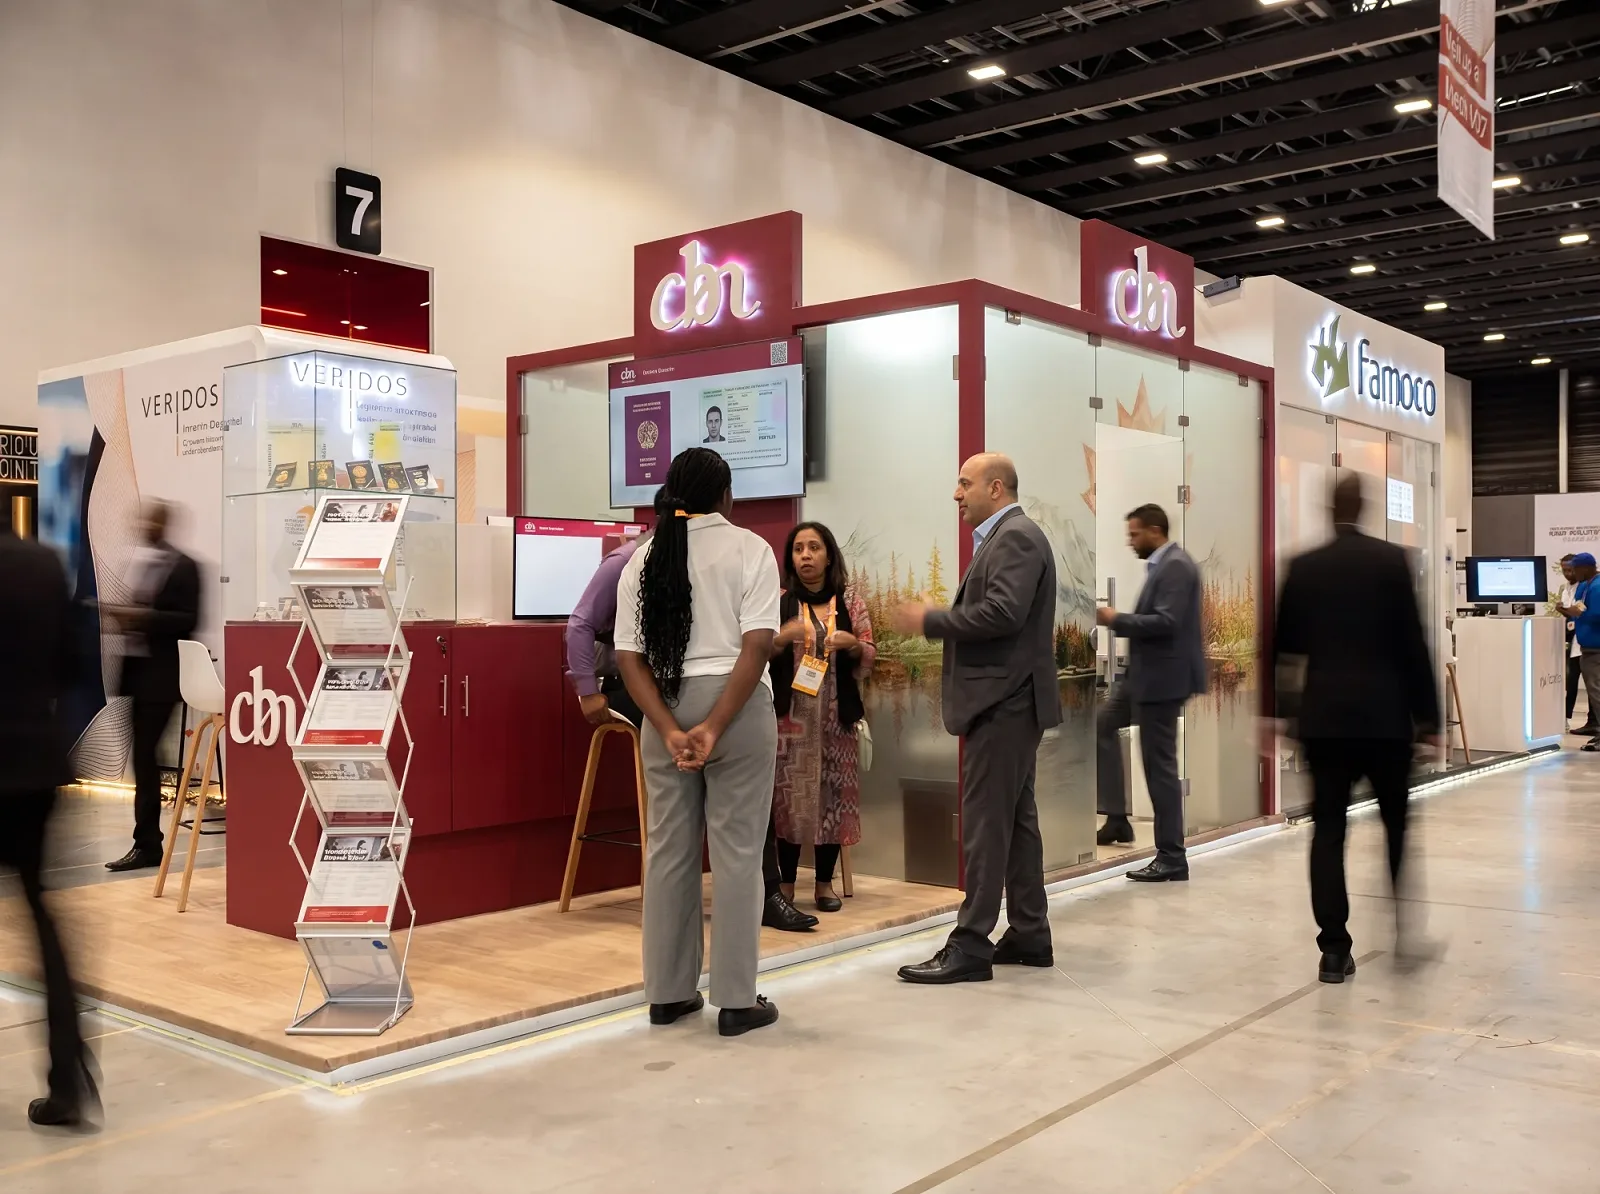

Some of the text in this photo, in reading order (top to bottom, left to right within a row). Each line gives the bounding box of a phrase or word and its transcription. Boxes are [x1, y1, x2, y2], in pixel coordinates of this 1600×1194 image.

[346, 185, 374, 236] 7
[651, 240, 761, 331] cbn
[1115, 245, 1187, 338] cbn
[141, 384, 218, 418] VERIDOS
[294, 361, 407, 396] VERIDOS
[229, 665, 297, 747] cbn
